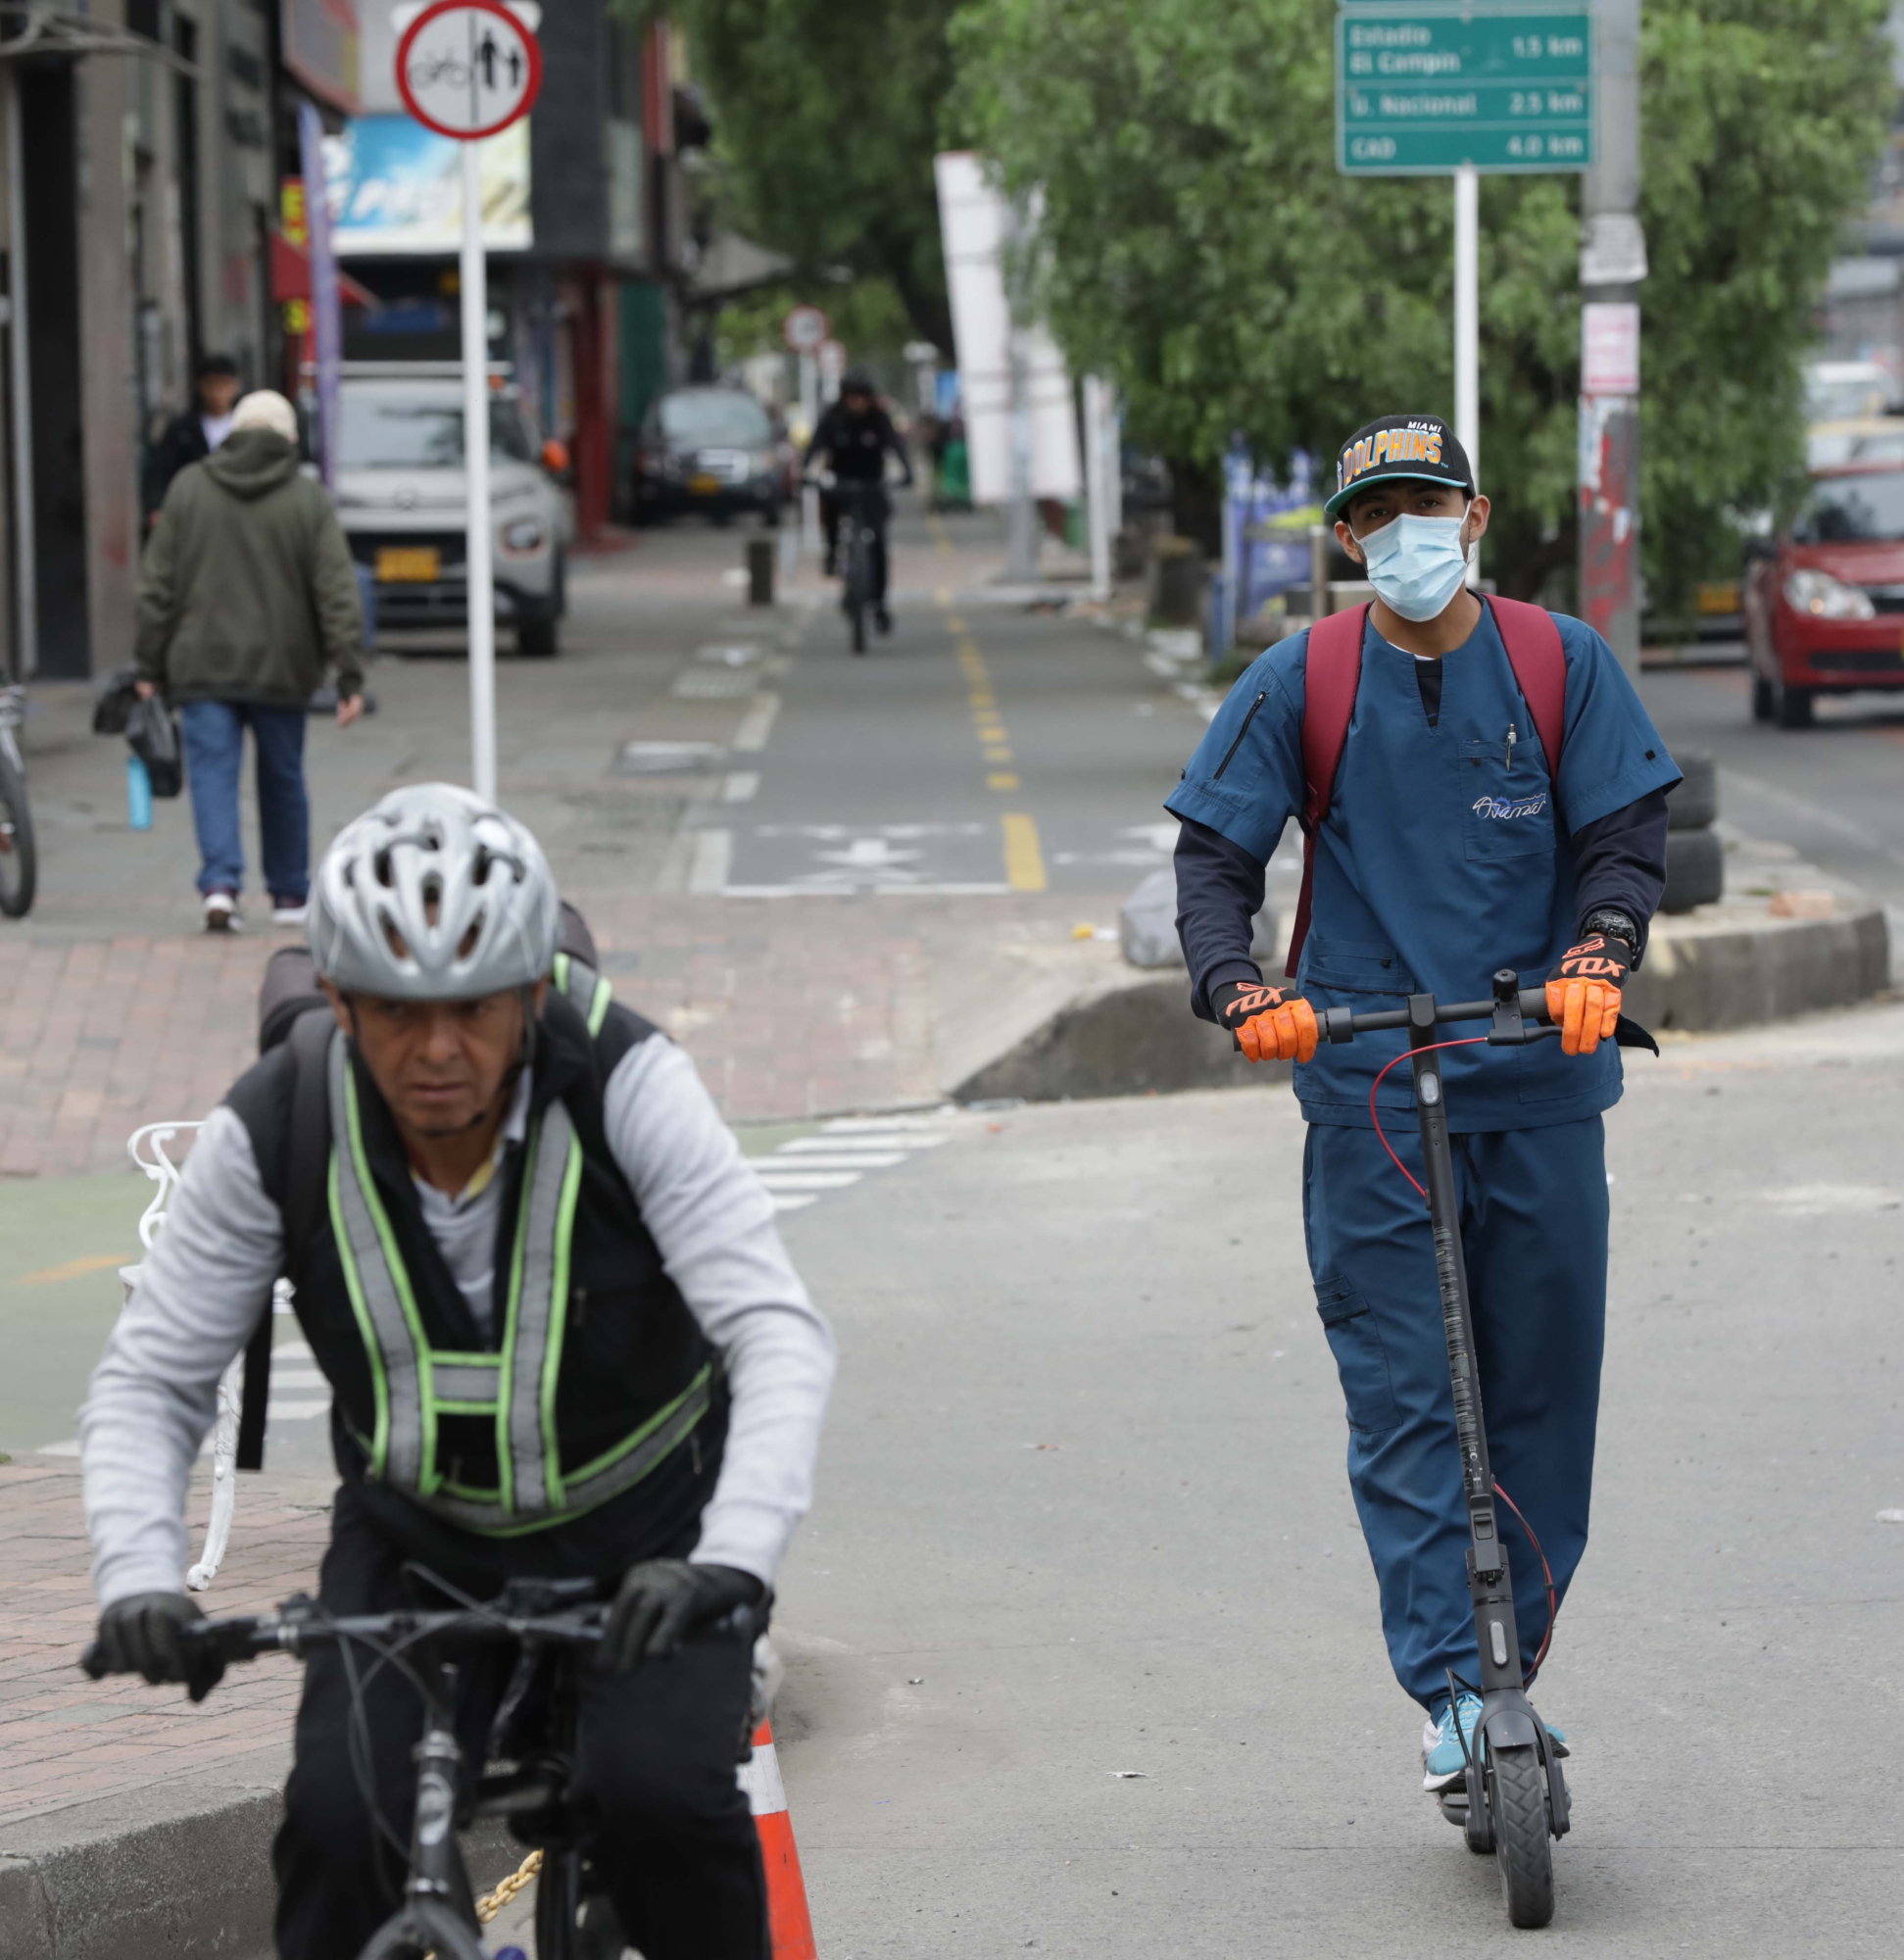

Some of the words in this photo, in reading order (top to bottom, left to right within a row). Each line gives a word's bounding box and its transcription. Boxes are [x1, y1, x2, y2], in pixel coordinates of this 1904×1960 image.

[1349, 24, 1432, 47] Estadio
[1547, 34, 1584, 57] km
[1349, 52, 1373, 74] El
[1379, 94, 1477, 117] Nacional
[1547, 90, 1584, 113] km
[1547, 132, 1584, 156] km
[1407, 420, 1442, 433] MIAMI
[1343, 428, 1442, 488] DOLPHINS
[1561, 956, 1626, 978] FOX
[1225, 987, 1288, 1017] FOX
